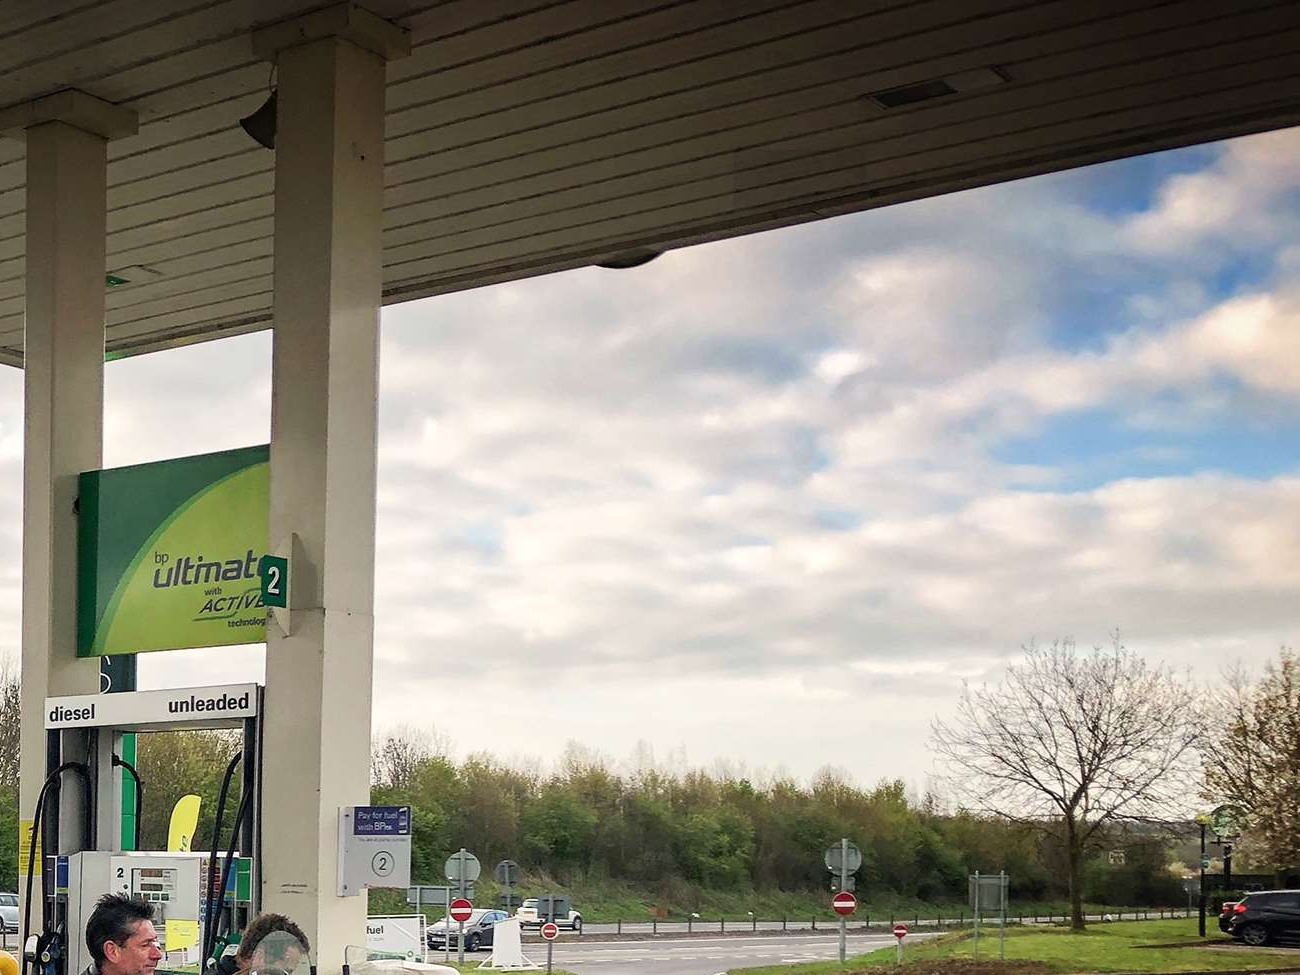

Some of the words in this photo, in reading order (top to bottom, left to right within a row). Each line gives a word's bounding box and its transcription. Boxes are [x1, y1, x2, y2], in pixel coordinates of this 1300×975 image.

[154, 552, 169, 565] bp
[267, 566, 280, 594] 2
[204, 587, 222, 596] with
[227, 617, 266, 628] technolog
[168, 692, 249, 713] unleaded
[49, 703, 96, 722] diesel
[358, 811, 370, 821] Pay
[372, 811, 383, 819] for
[384, 811, 398, 819] fuel
[358, 823, 373, 831] with
[379, 857, 387, 871] 2
[116, 867, 125, 878] 2
[366, 925, 384, 935] fuel
